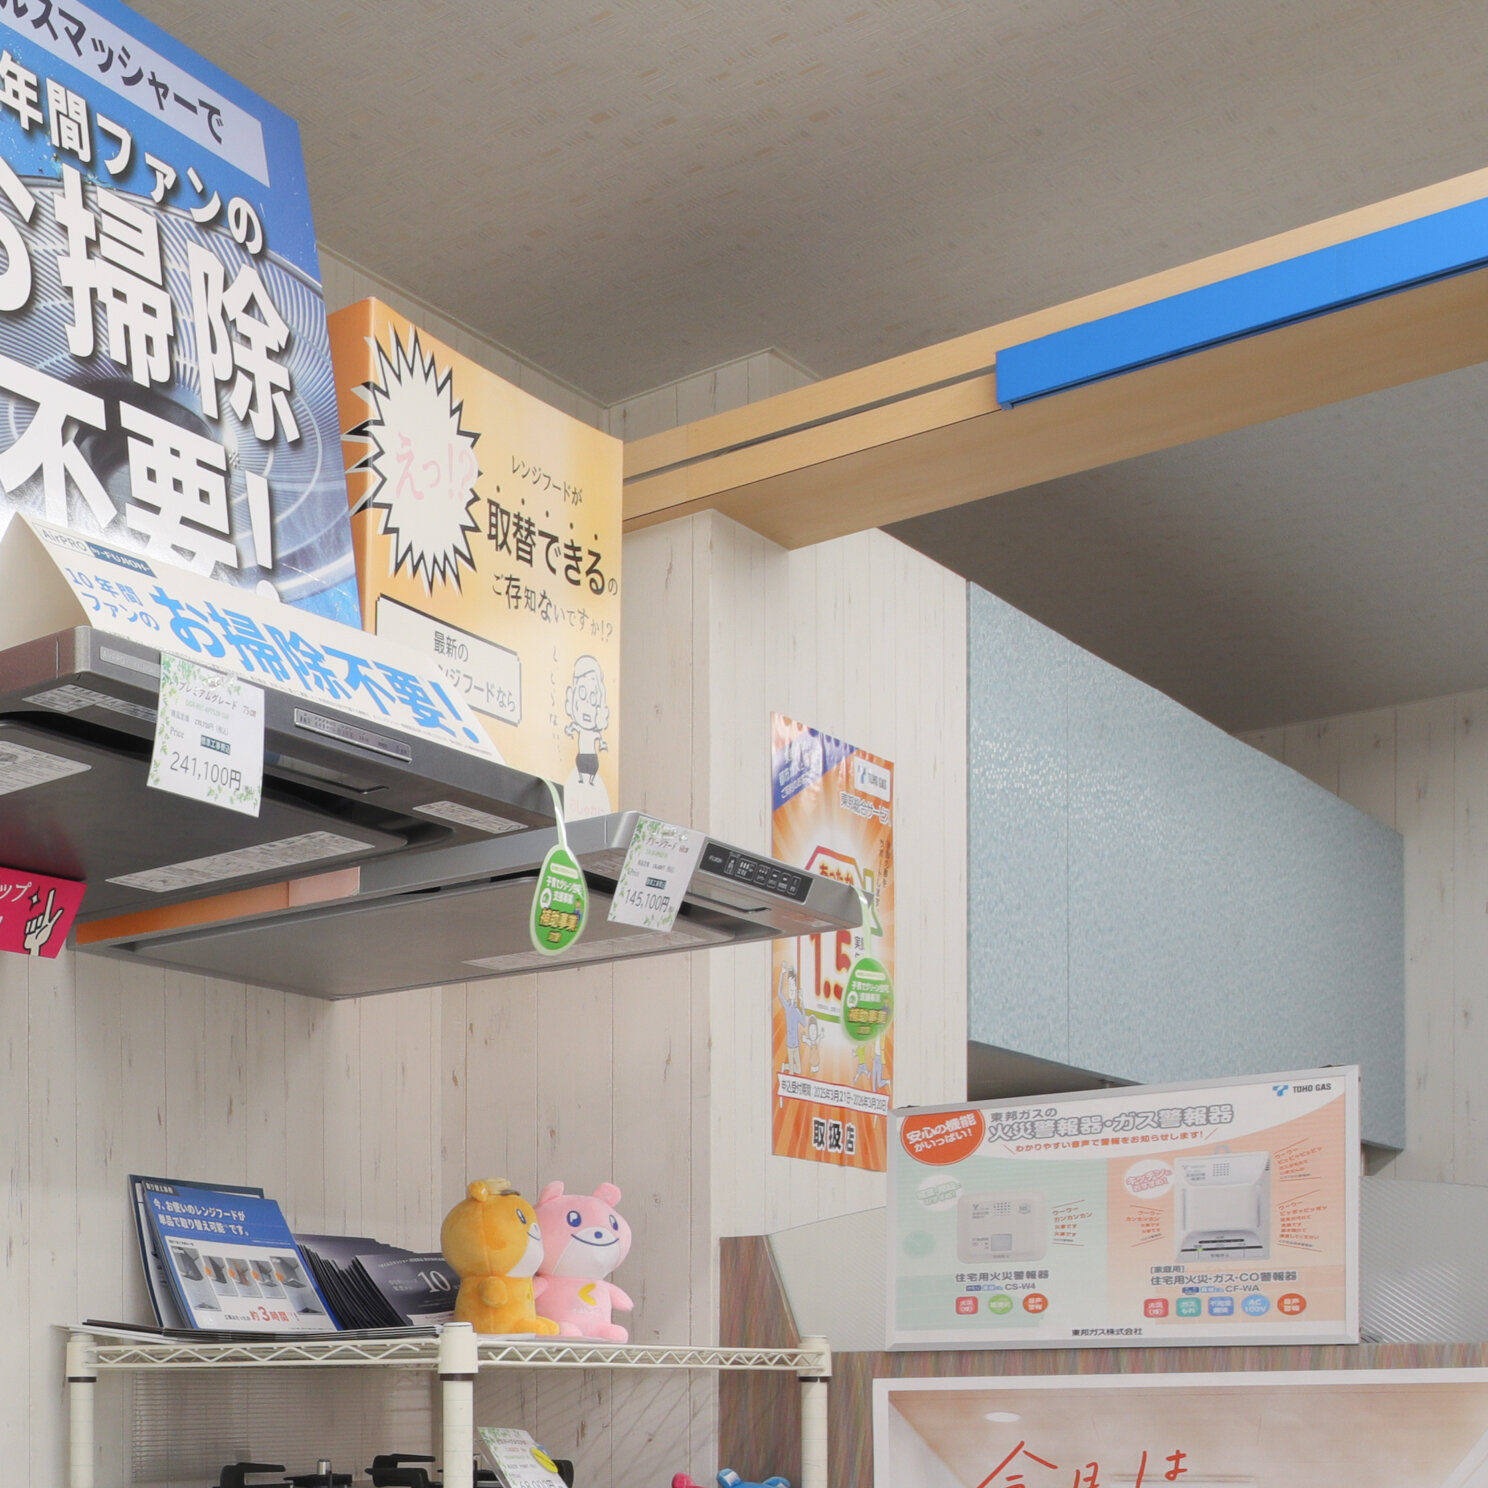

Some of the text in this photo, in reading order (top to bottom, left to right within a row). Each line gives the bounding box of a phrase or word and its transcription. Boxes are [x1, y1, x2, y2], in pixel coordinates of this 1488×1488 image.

[511, 454, 584, 507] レンジフードが
[65, 567, 141, 606] 10年間
[80, 592, 161, 632] ファンの
[434, 631, 469, 663] 最新の
[170, 752, 241, 791] 241,100円
[625, 889, 670, 913] 145,100円
[1293, 1083, 1331, 1093] TOHO GAS
[988, 1104, 1234, 1144] 火災警報器・ガス警報器
[991, 1108, 1057, 1123] 東邦ガスの
[813, 1119, 855, 1153] 取扱店
[906, 1113, 976, 1143] 安心の機能
[153, 1199, 245, 1221] 今、お使いのレンジフードが
[418, 1270, 451, 1293] 10
[955, 1270, 1049, 1282] 住宅用火災警報器
[1005, 1282, 1036, 1291] CS-W4
[1225, 1284, 1259, 1293] CF-WA
[1072, 1328, 1143, 1336] 東邦ガス株式会社
